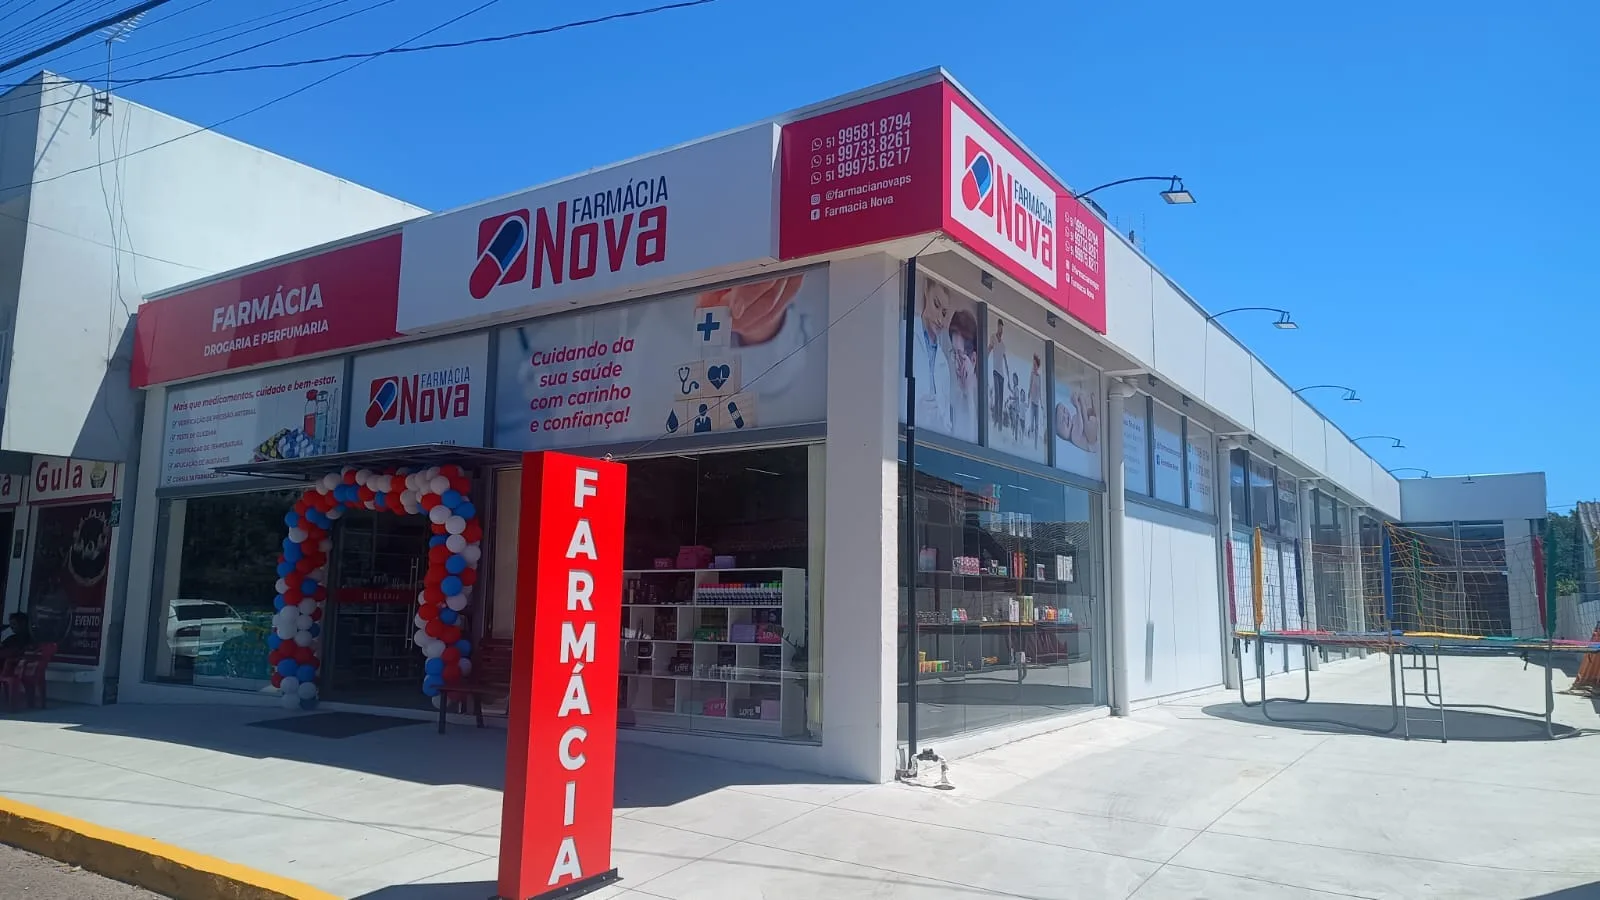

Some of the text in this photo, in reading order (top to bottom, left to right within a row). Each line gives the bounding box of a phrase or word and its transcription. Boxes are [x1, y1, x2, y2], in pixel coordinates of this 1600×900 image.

[826, 112, 912, 148] 51 99581.8794
[826, 129, 910, 165] 51 99733.8261
[825, 147, 911, 182] 51 99975.6217
[572, 176, 668, 224] FARMÁCIA
[826, 175, 912, 201] @farmacianovaps
[871, 196, 894, 208] Nova
[1015, 180, 1053, 227] FARMÁCIA
[997, 165, 1052, 270] Nova
[532, 201, 667, 289] Nova
[212, 283, 324, 332] FARMÁCIA
[204, 320, 329, 357] DROGARIA E PERFUMARIA
[531, 336, 635, 366] Cuidando da
[421, 365, 470, 388] FARMÁCIA
[540, 361, 623, 387] sua saúde
[173, 376, 337, 412] Mais que medicamentos, cuidado e bem-estar.
[400, 374, 470, 425] Nova
[530, 384, 631, 410] com carinho
[530, 406, 630, 432] e confiança!
[36, 458, 83, 492] Gula
[75, 615, 100, 626] EVENTO
[547, 467, 598, 885] FARMÁCIA
